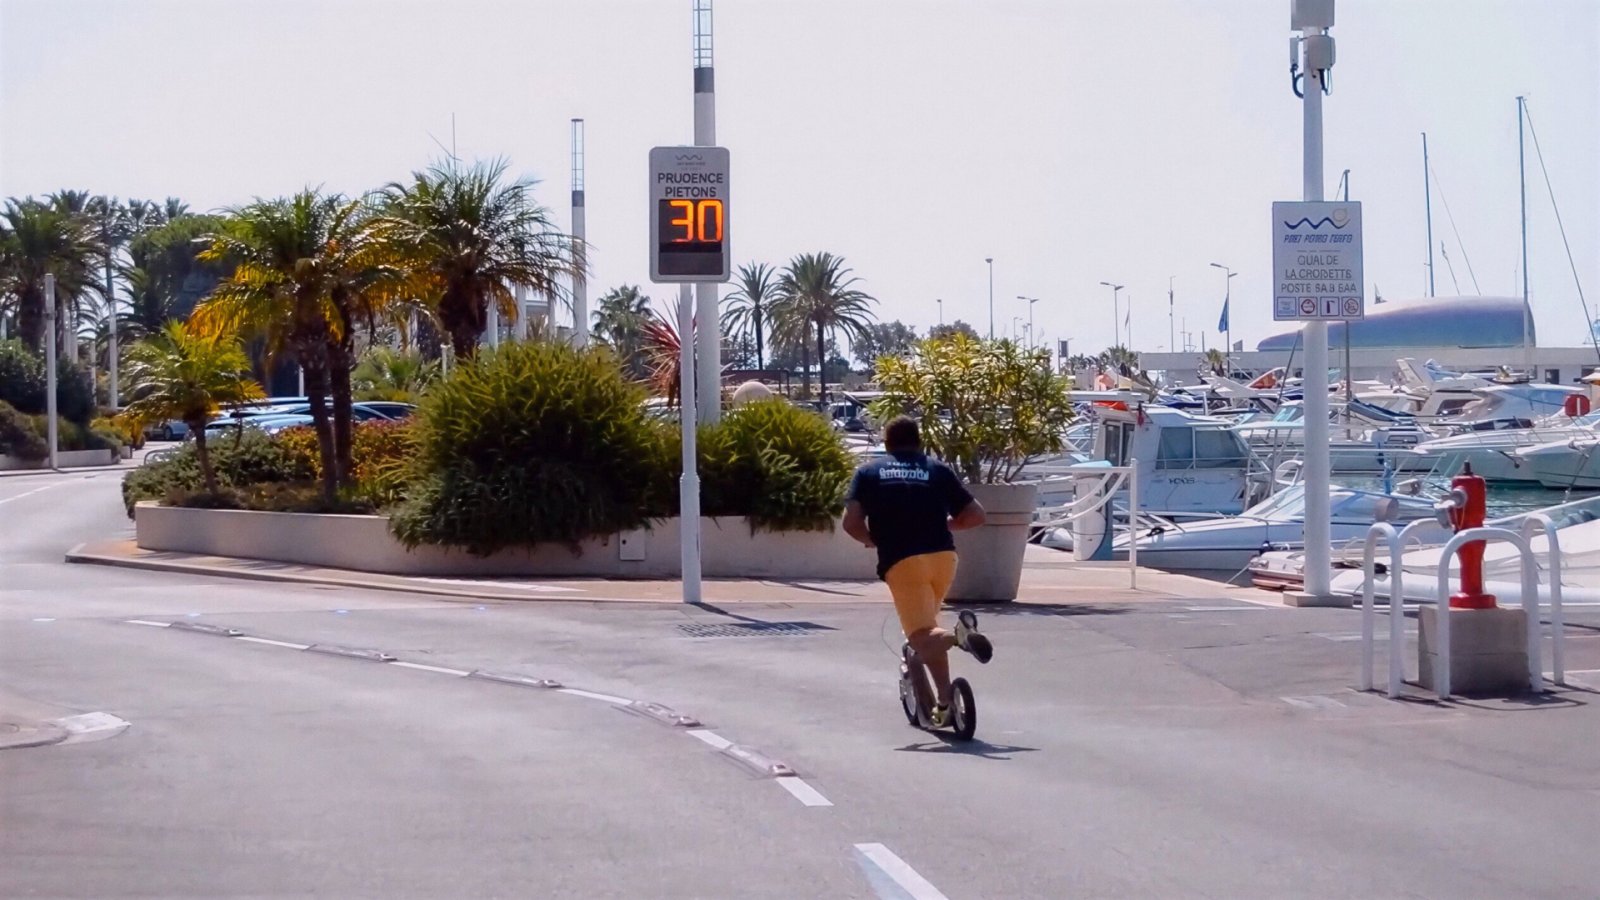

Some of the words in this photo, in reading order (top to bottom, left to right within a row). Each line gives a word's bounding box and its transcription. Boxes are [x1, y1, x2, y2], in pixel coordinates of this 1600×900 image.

[665, 186, 717, 197] PIETONS
[670, 200, 723, 242] 30
[1285, 269, 1297, 279] LA
[1281, 283, 1311, 293] POSTE
